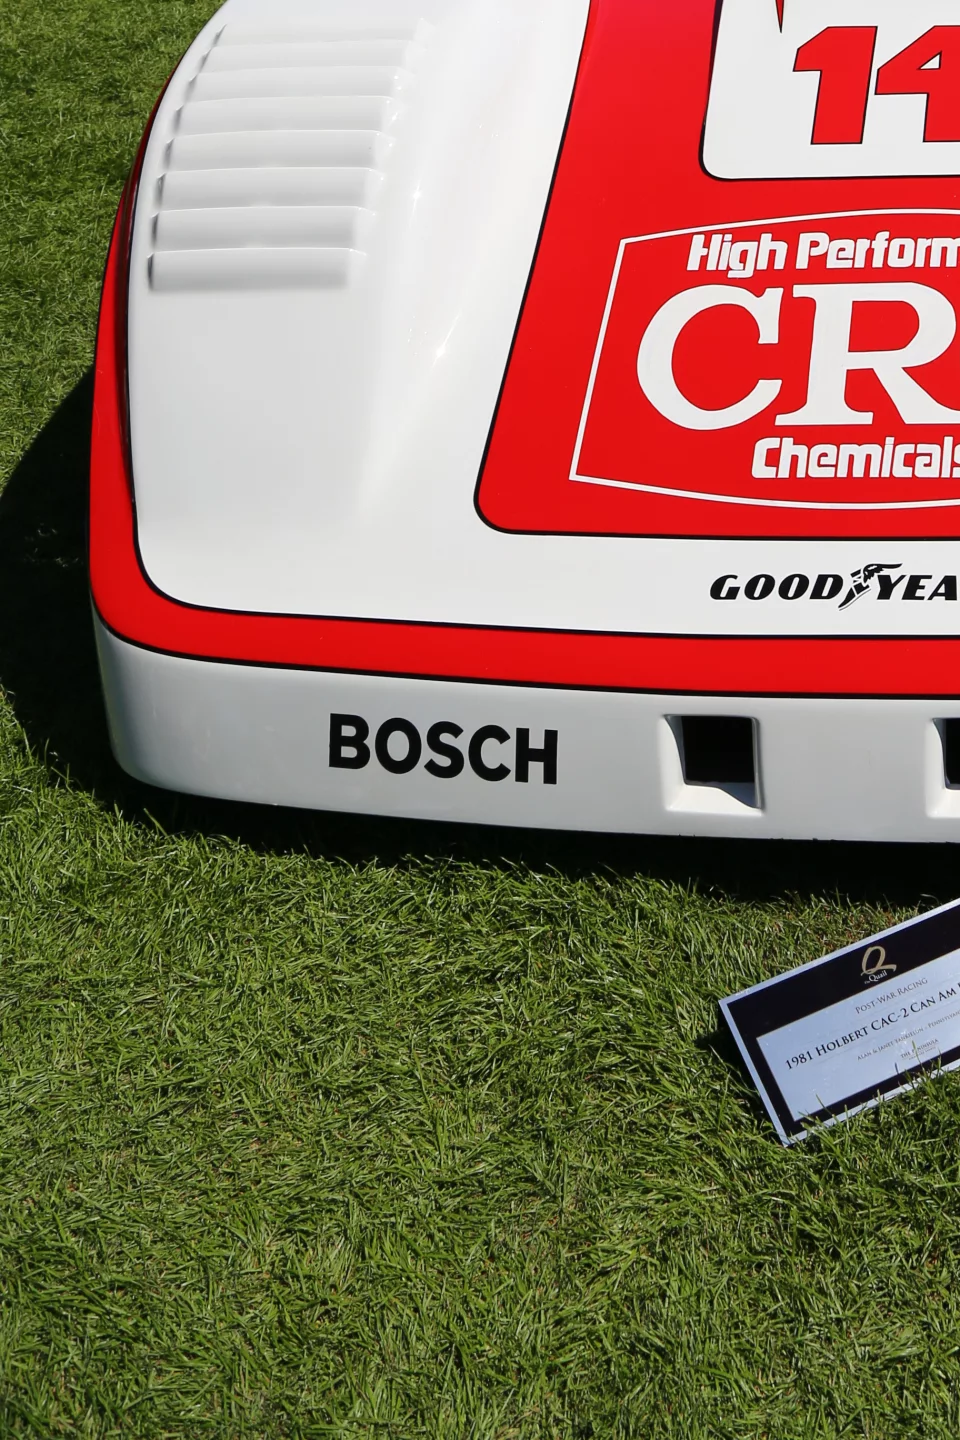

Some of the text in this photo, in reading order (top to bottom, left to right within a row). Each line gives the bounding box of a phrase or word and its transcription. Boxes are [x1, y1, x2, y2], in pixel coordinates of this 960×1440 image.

[686, 232, 786, 278] High
[328, 713, 559, 785] BOSCH
[868, 970, 888, 982] Quail
[897, 977, 928, 995] RACING
[785, 1050, 813, 1070] 1981
[815, 1026, 869, 1056] HOLBERT
[871, 1007, 910, 1031] CAC-2
[910, 996, 936, 1013] CAN
[938, 987, 957, 1001] AM
[857, 1051, 872, 1061] ALAN
